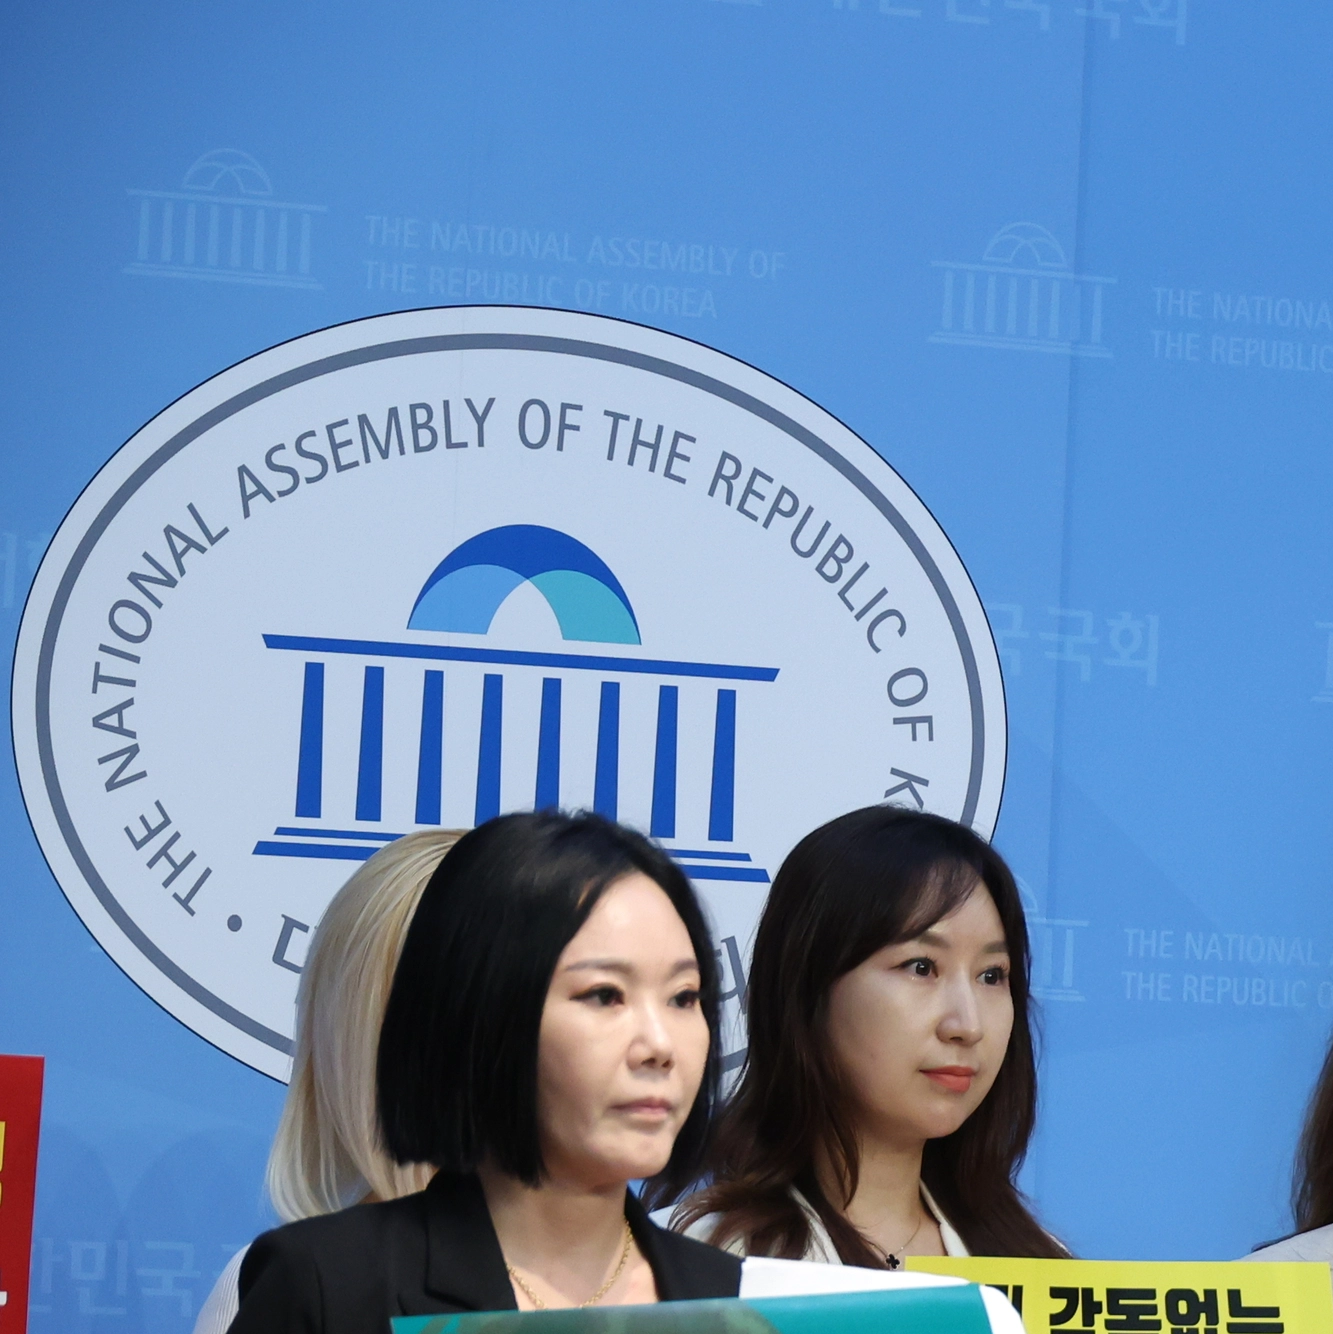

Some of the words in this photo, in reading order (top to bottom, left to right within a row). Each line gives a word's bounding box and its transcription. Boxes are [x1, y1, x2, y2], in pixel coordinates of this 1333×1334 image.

[364, 213, 420, 249] THE
[430, 220, 577, 264] NATIONAL
[587, 235, 739, 277] ASSEMBLY
[750, 249, 786, 280] OF
[363, 260, 417, 295] THE
[427, 264, 565, 306] REPUBLIC
[574, 278, 611, 309] OF
[621, 282, 718, 318] KOREA
[1151, 285, 1202, 320] THE
[1151, 329, 1201, 362] THE
[236, 397, 496, 518] ASSEMBLY
[518, 398, 584, 451] OF
[603, 409, 698, 485] THE
[707, 450, 907, 653] REPUBLIC
[92, 502, 230, 792] NATIONAL
[885, 666, 934, 744] OF
[125, 799, 213, 916] THE
[1123, 927, 1175, 960] THE
[1184, 930, 1321, 967] NATIONAL
[1121, 970, 1173, 1003] THE
[1182, 973, 1307, 1009] REPUBLIC
